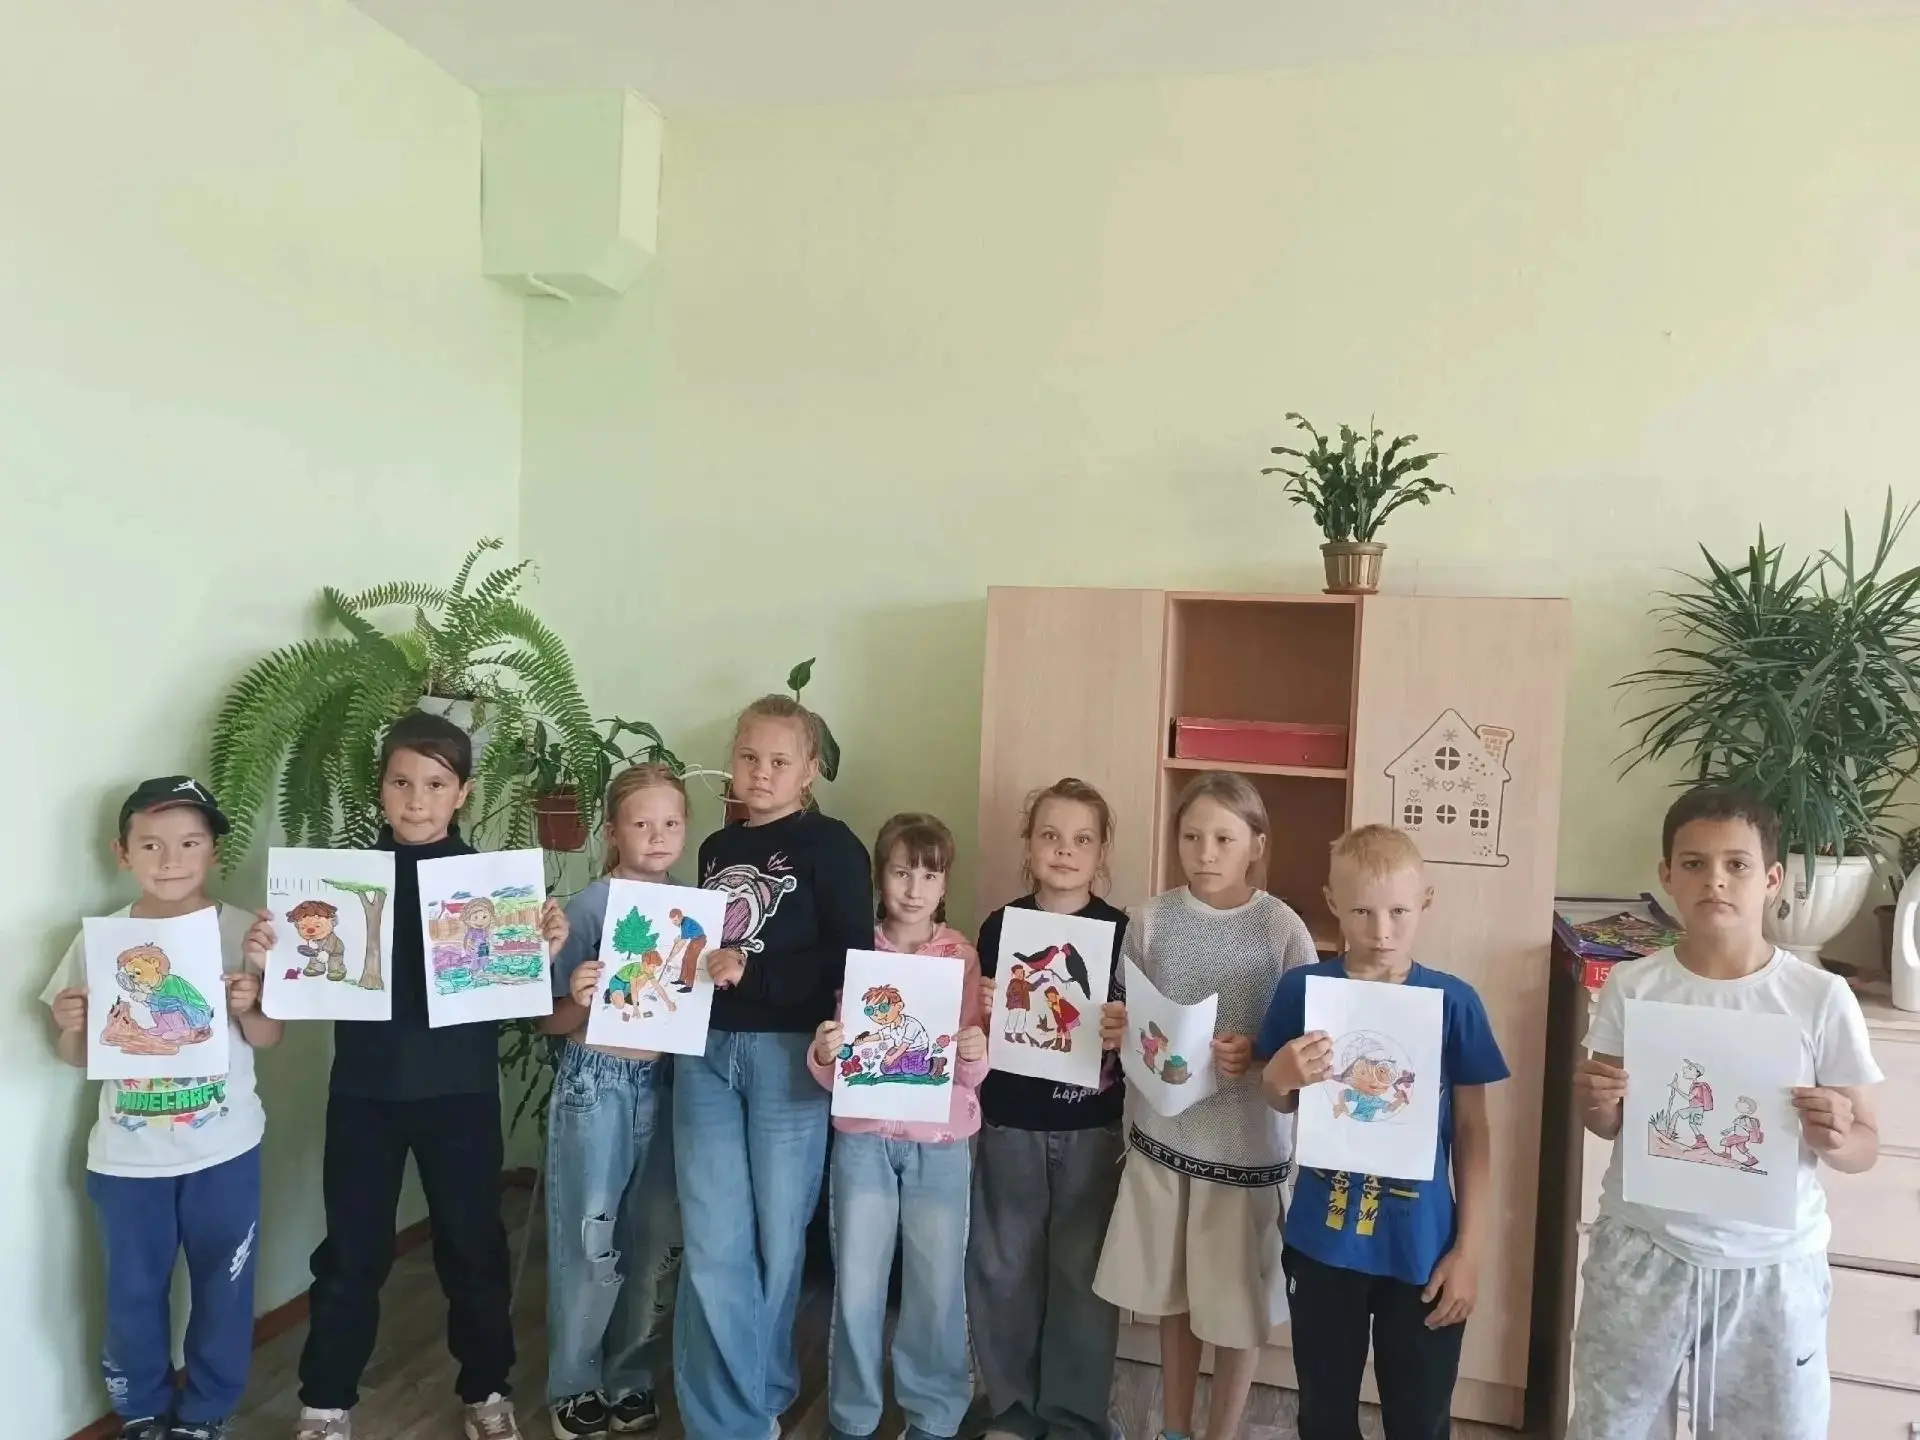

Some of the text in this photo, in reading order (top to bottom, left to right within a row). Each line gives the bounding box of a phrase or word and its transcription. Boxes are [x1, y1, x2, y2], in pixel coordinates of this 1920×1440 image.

[115, 1080, 226, 1115] MINECRAFT
[1184, 1160, 1210, 1175] MY
[1213, 1167, 1280, 1184] PLANET
